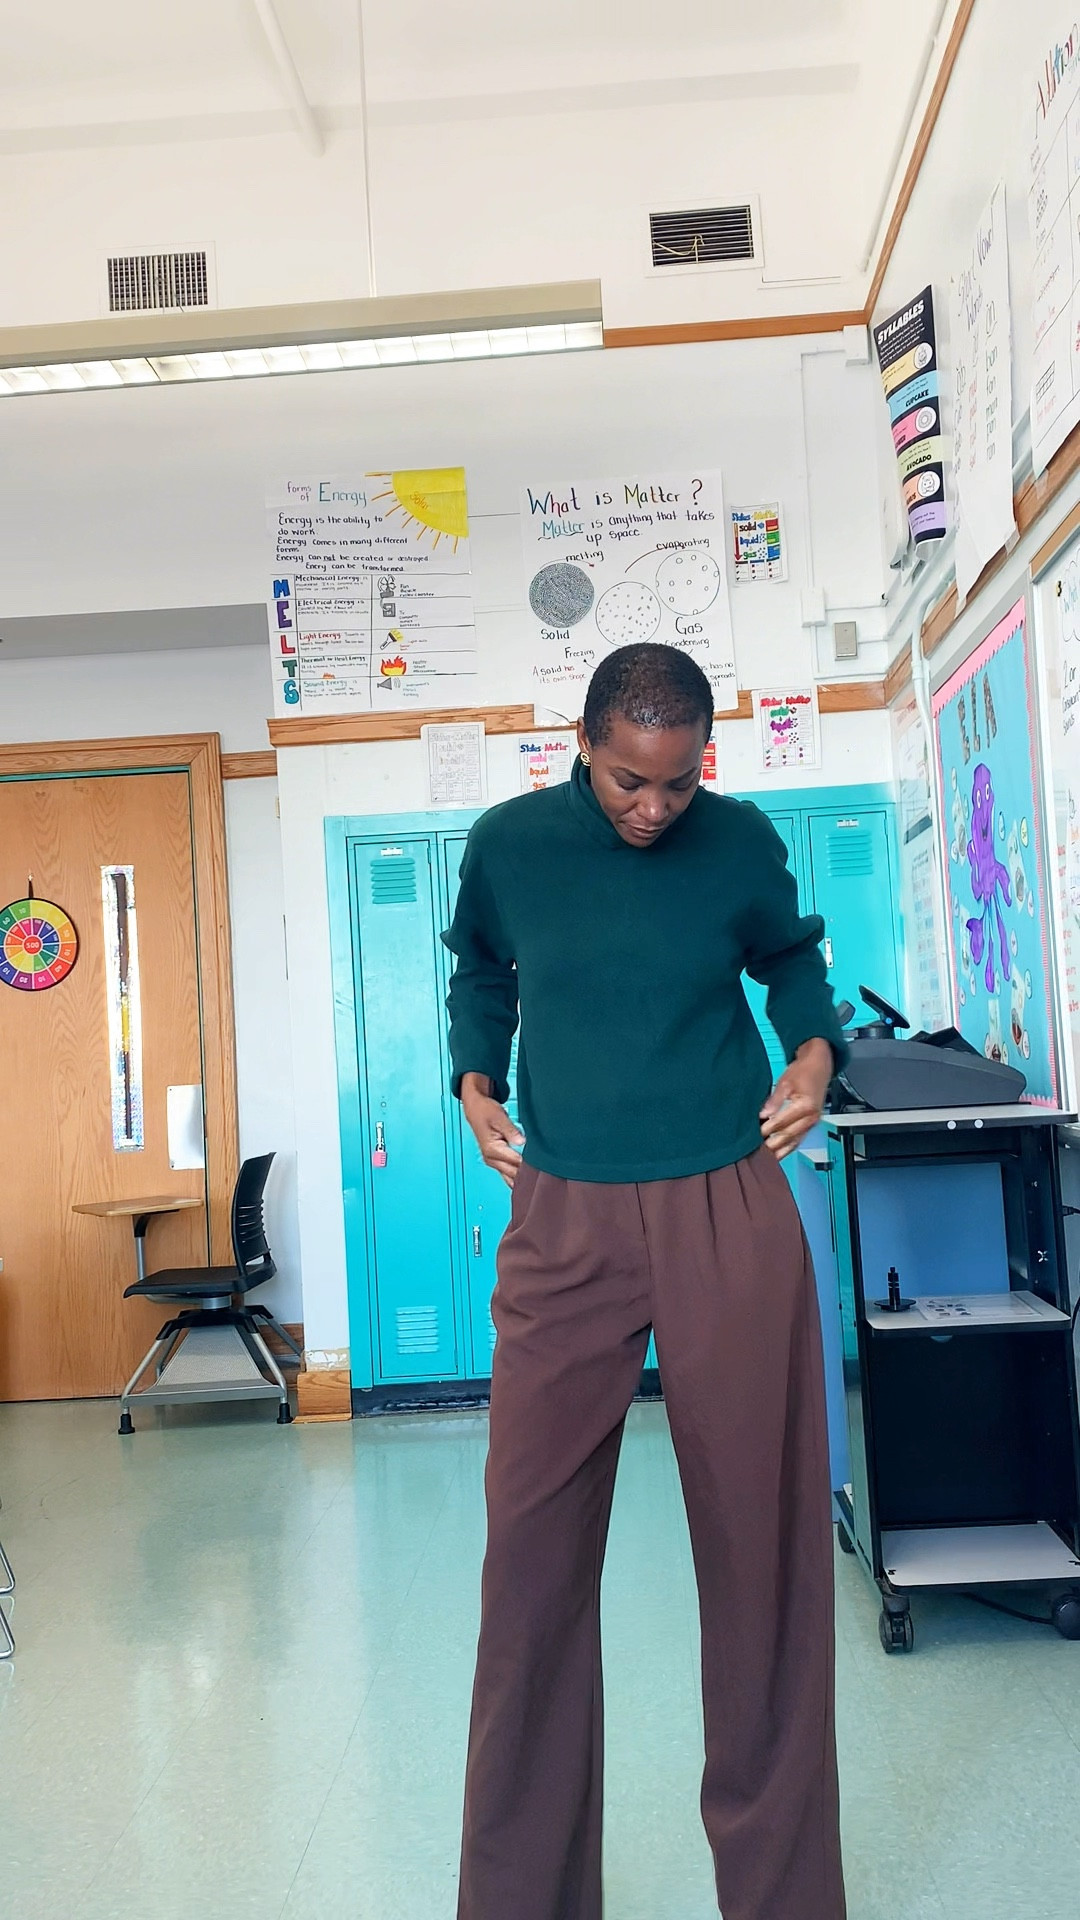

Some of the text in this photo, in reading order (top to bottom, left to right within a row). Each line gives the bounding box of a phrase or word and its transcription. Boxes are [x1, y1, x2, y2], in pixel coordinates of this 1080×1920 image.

[878, 299, 925, 345] SYLLABLES
[905, 389, 929, 407] CUPCAKE
[906, 454, 932, 471] AVOCADO
[287, 481, 311, 493] forms
[300, 482, 367, 508] of Energy
[527, 478, 703, 517] What is Matter ?
[278, 512, 383, 529] Energy is the ability to
[542, 509, 715, 539] Matter is anything that takes
[739, 521, 757, 532] solid
[277, 536, 307, 546] Energy
[349, 538, 372, 547] many
[586, 534, 602, 546] up
[740, 534, 759, 547] liquid
[565, 537, 710, 562] melting evaporating
[743, 551, 757, 560] gas
[275, 554, 304, 563] Energy
[397, 555, 429, 563] destroyed
[297, 599, 332, 607] Electrical
[675, 616, 703, 636] Gas
[299, 633, 317, 642] Light
[318, 632, 341, 640] Energy
[541, 628, 570, 641] Solid
[564, 646, 595, 659] Freezing
[532, 665, 539, 677] A
[540, 665, 562, 676] solid
[709, 672, 736, 681] spreads
[958, 672, 997, 765] ELA
[520, 742, 569, 753] States Matter
[529, 765, 549, 778] liquid
[25, 941, 40, 949] 500
